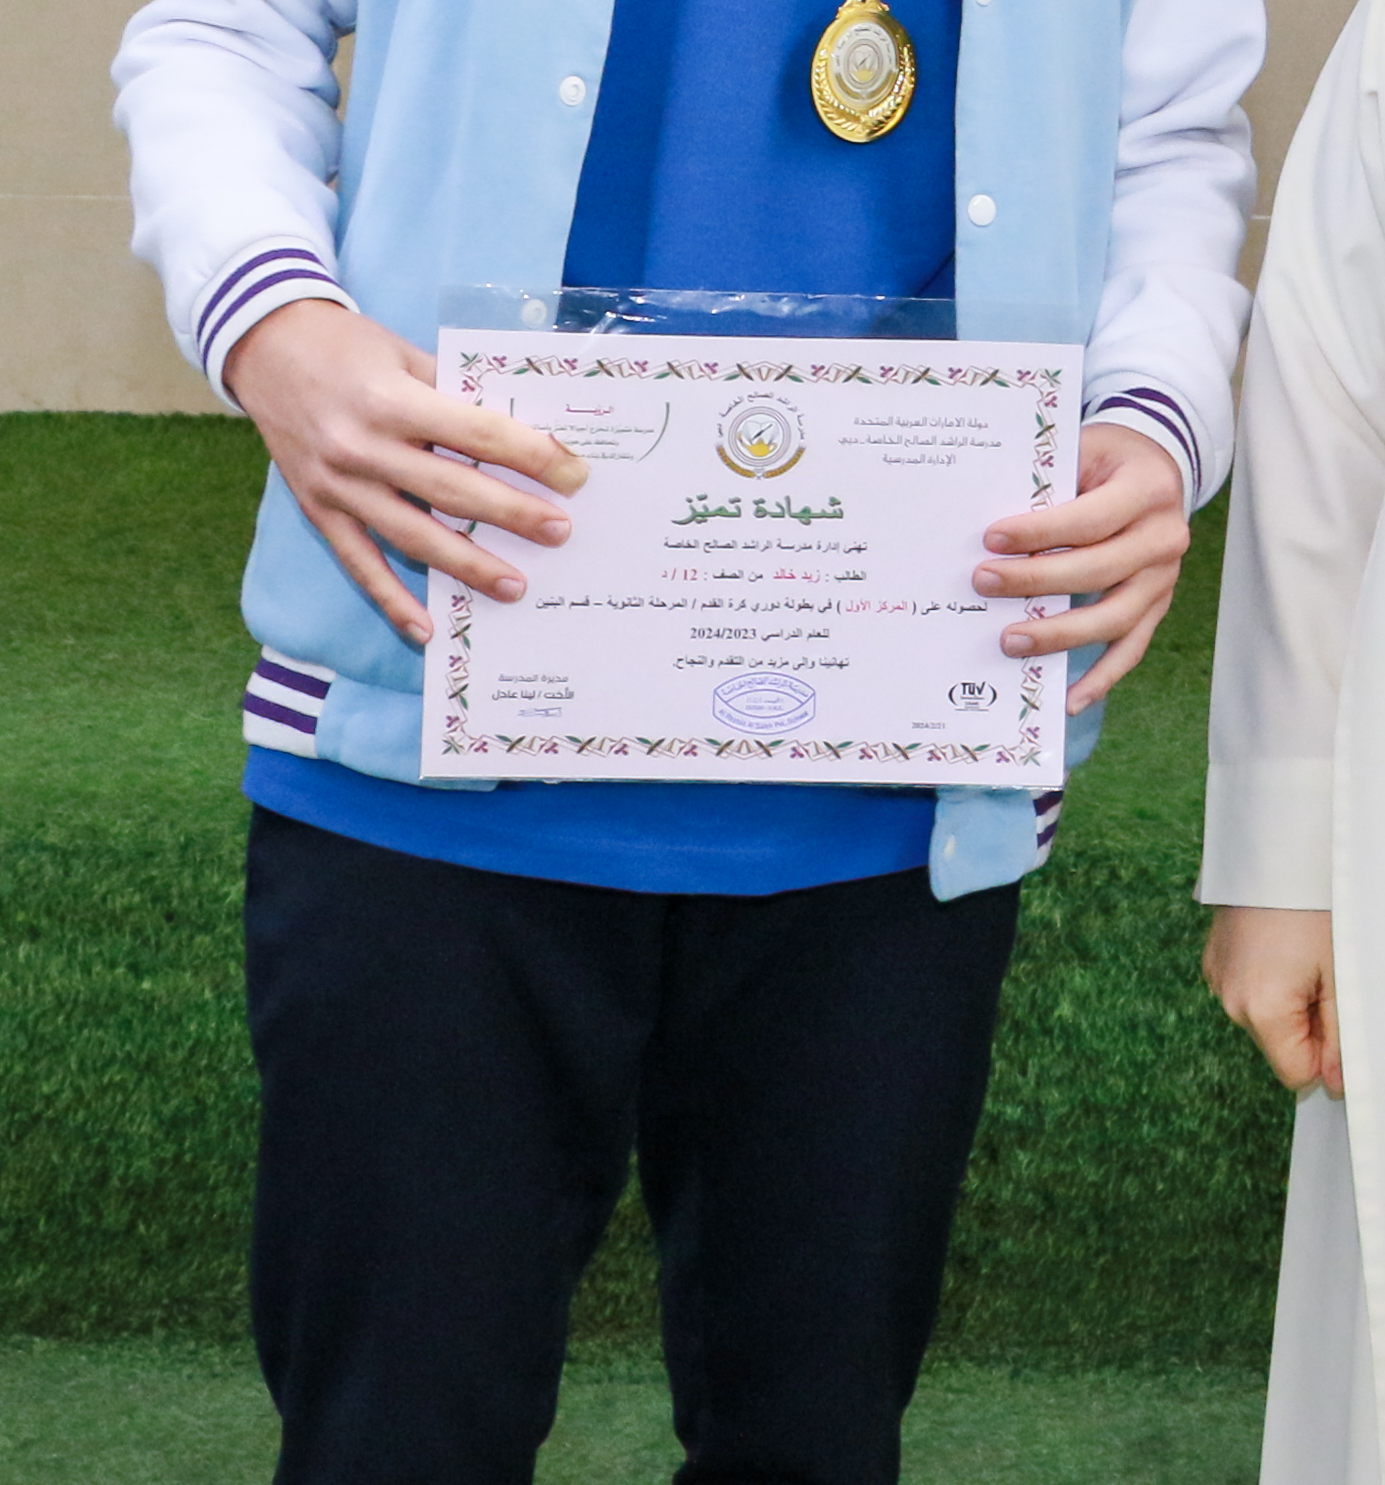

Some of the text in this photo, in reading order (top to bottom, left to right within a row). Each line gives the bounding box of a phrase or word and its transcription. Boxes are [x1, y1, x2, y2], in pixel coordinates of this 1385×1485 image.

[854, 416, 893, 426] المتحدة
[904, 435, 937, 447] الصالح
[939, 436, 968, 448] الراشد
[970, 437, 1002, 449] مدرسة
[753, 495, 844, 526] شهادة
[664, 537, 700, 549] الخاصة
[703, 539, 738, 553] الصالح
[742, 539, 772, 553] الراشد
[777, 538, 812, 553] مدرسة
[683, 569, 698, 581] 12
[748, 571, 763, 582] من
[773, 568, 796, 580] خالد
[801, 569, 820, 583] زيد
[834, 569, 866, 581] الطالب
[536, 596, 565, 609] البنين
[569, 594, 590, 609] قسم
[607, 594, 644, 609] الثانوية
[648, 595, 688, 610] المرحلة
[701, 597, 724, 611] القدم
[728, 597, 747, 611] كرة
[784, 597, 814, 612] بطولة
[876, 600, 907, 613] المركز
[921, 601, 941, 615] على
[946, 601, 987, 614] لحصوله
[690, 627, 757, 639] 2024/2023
[761, 627, 803, 641] الدراسي
[717, 655, 745, 668] التقدم
[748, 658, 763, 668] من
[768, 656, 789, 669] مزيد
[498, 673, 569, 684] مديرة المدرسة
[492, 689, 519, 700] عادل
[521, 689, 536, 700] لينا
